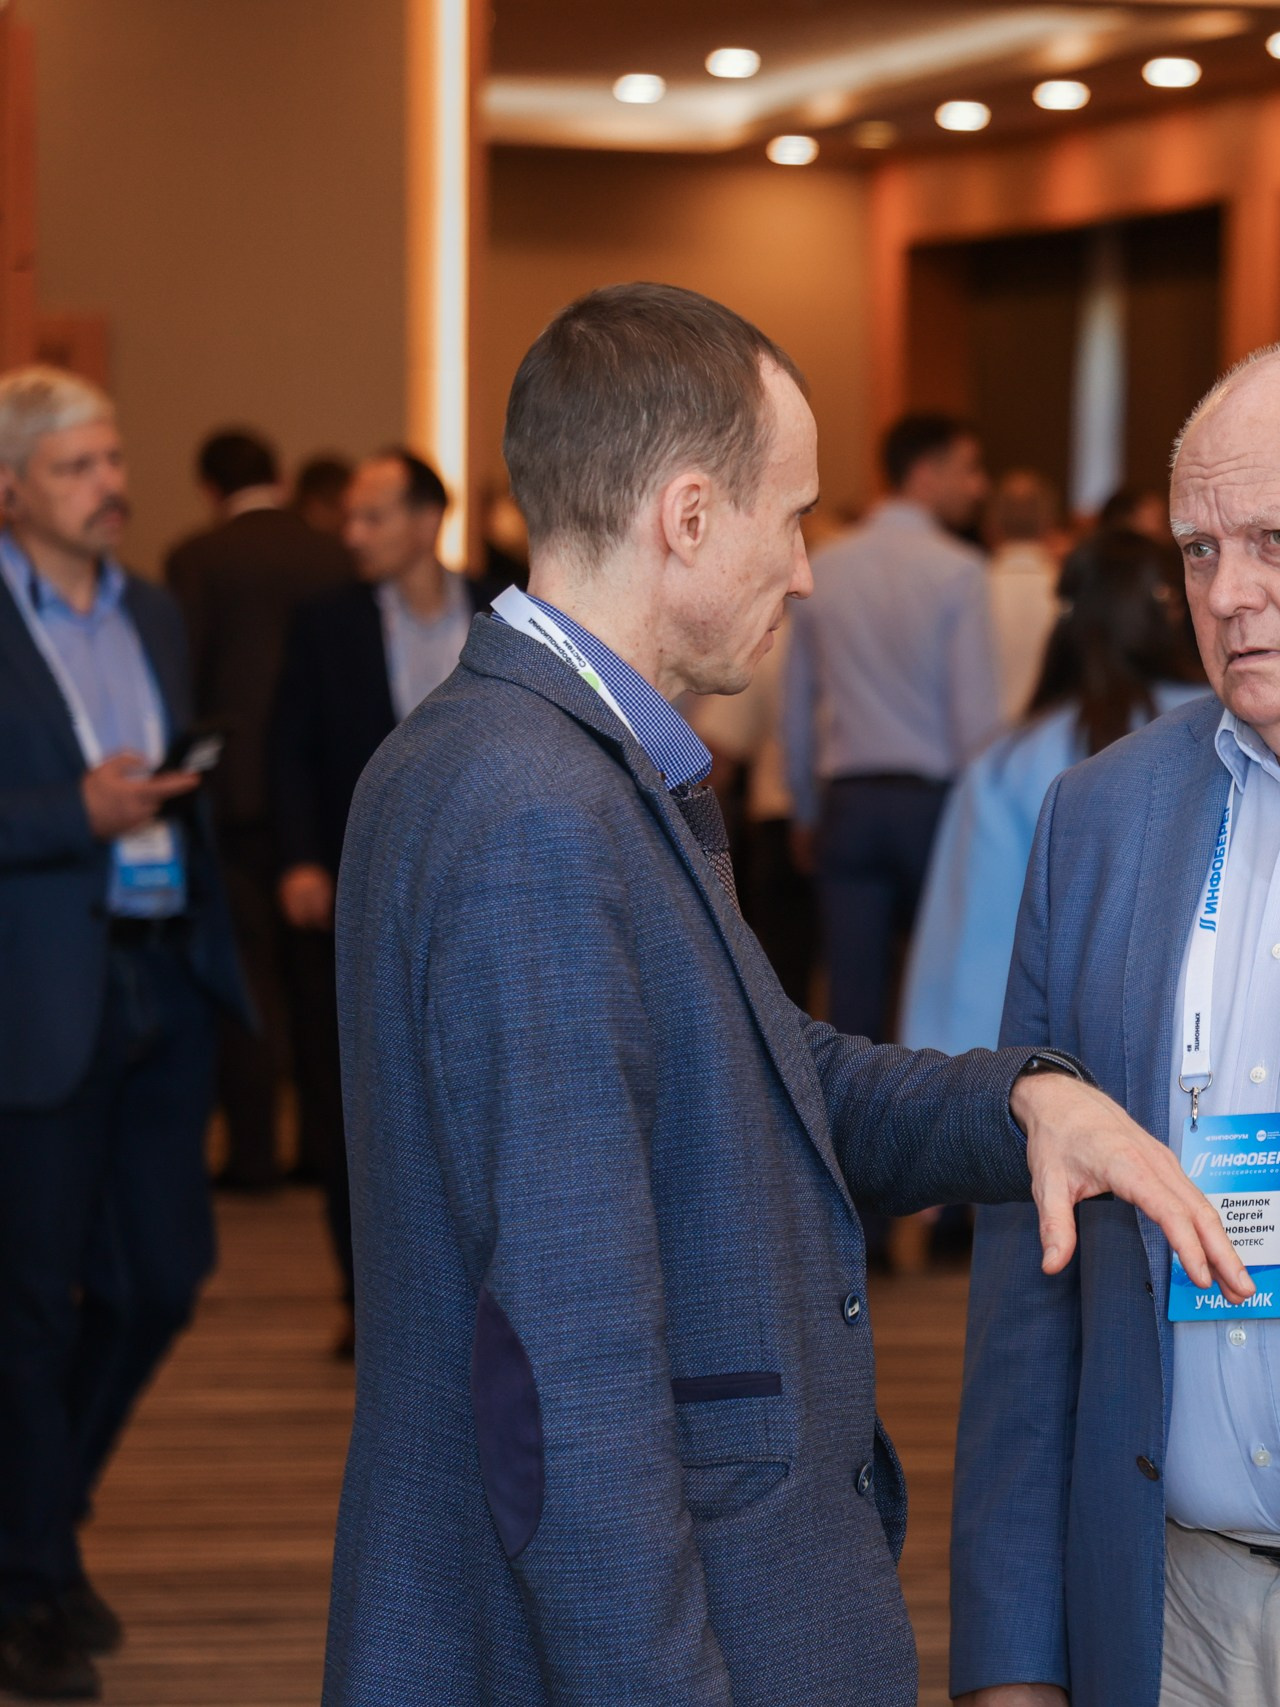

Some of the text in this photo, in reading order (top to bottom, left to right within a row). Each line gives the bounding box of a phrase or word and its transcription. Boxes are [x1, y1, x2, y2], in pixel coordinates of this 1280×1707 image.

[562, 639, 587, 668] Систем
[1220, 1198, 1271, 1209] Данилюк
[1226, 1209, 1263, 1222] Сергей
[1222, 1224, 1275, 1234] новьевич
[1230, 1238, 1264, 1247] ФОТЕКС
[1194, 1292, 1274, 1310] УЧАНИК
